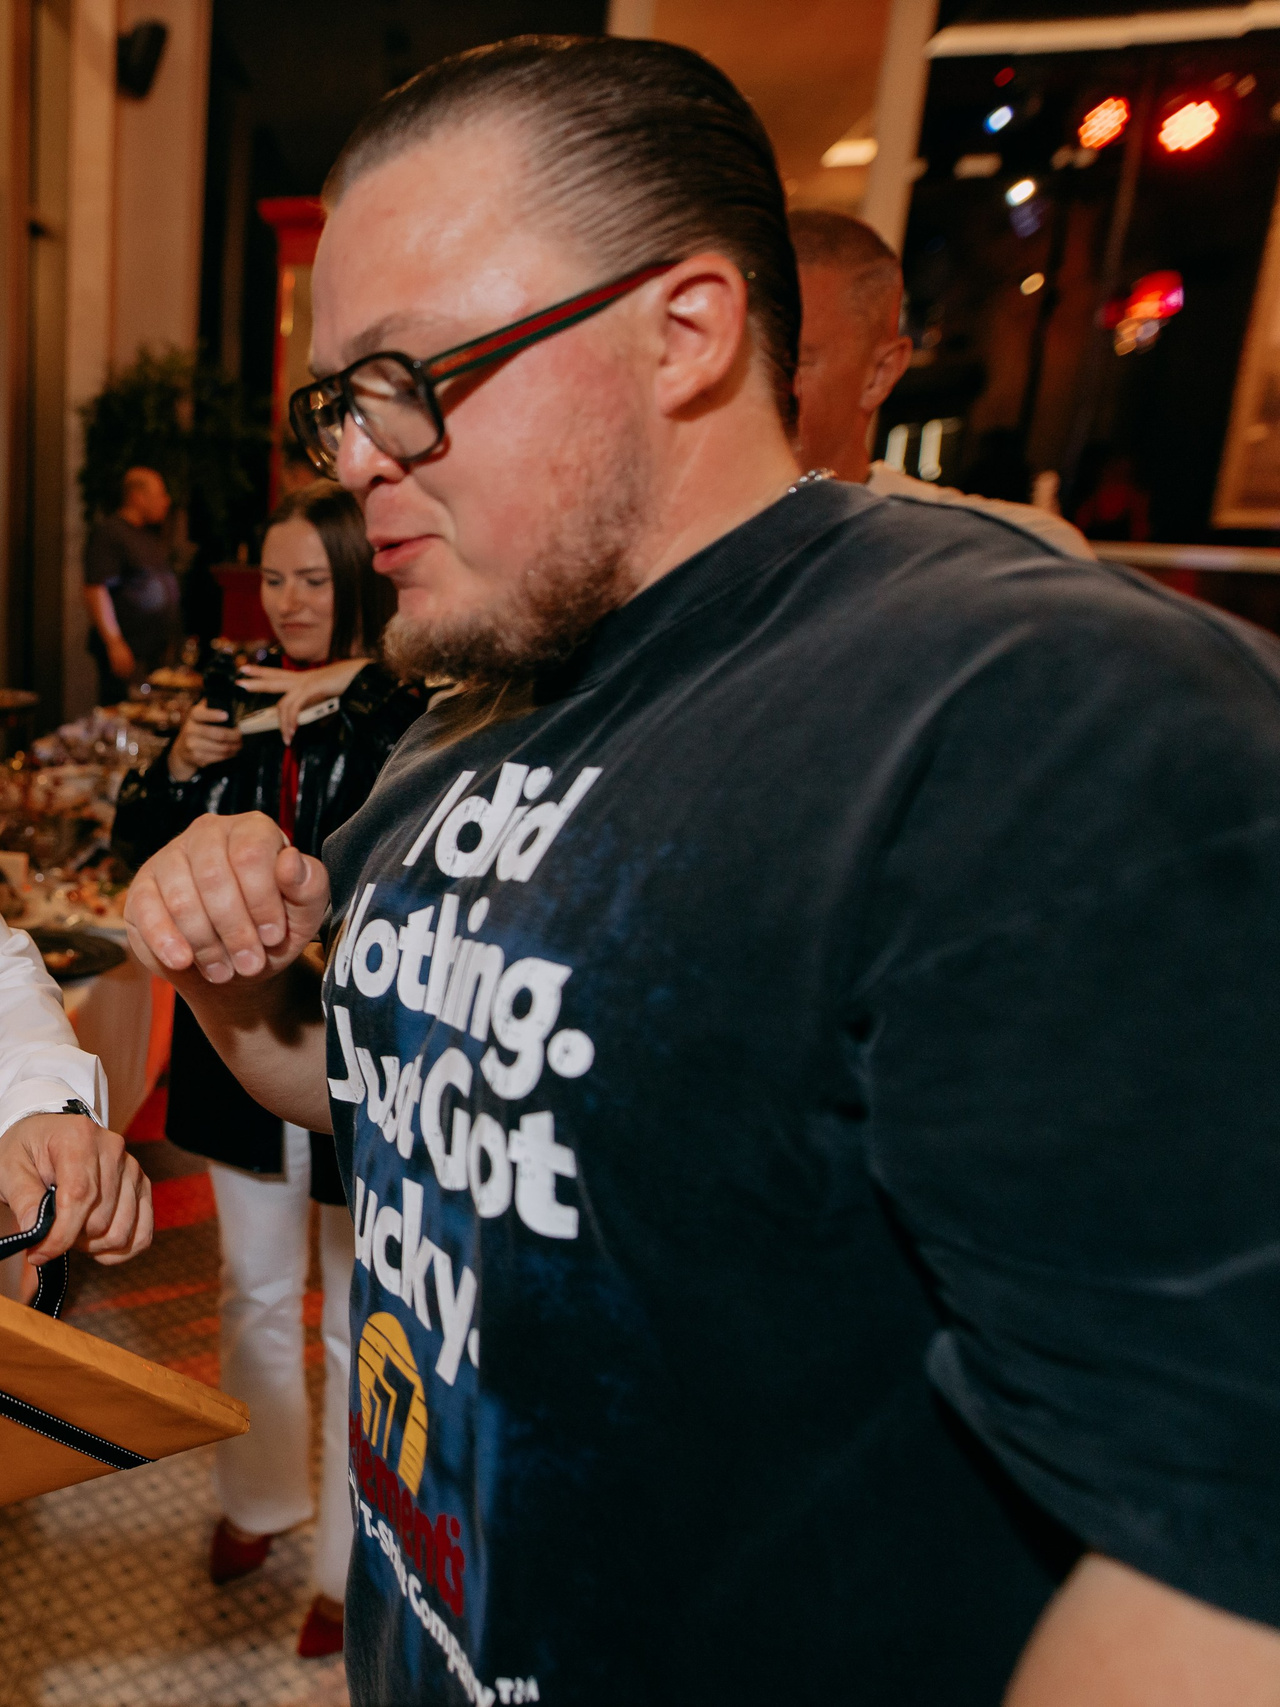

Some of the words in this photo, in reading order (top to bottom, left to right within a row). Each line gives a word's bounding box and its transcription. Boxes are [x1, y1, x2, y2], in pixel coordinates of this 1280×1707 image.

[402, 770, 478, 867] I
[435, 761, 604, 883] did
[420, 1047, 579, 1240] Got
[354, 1175, 480, 1387] ucky.
